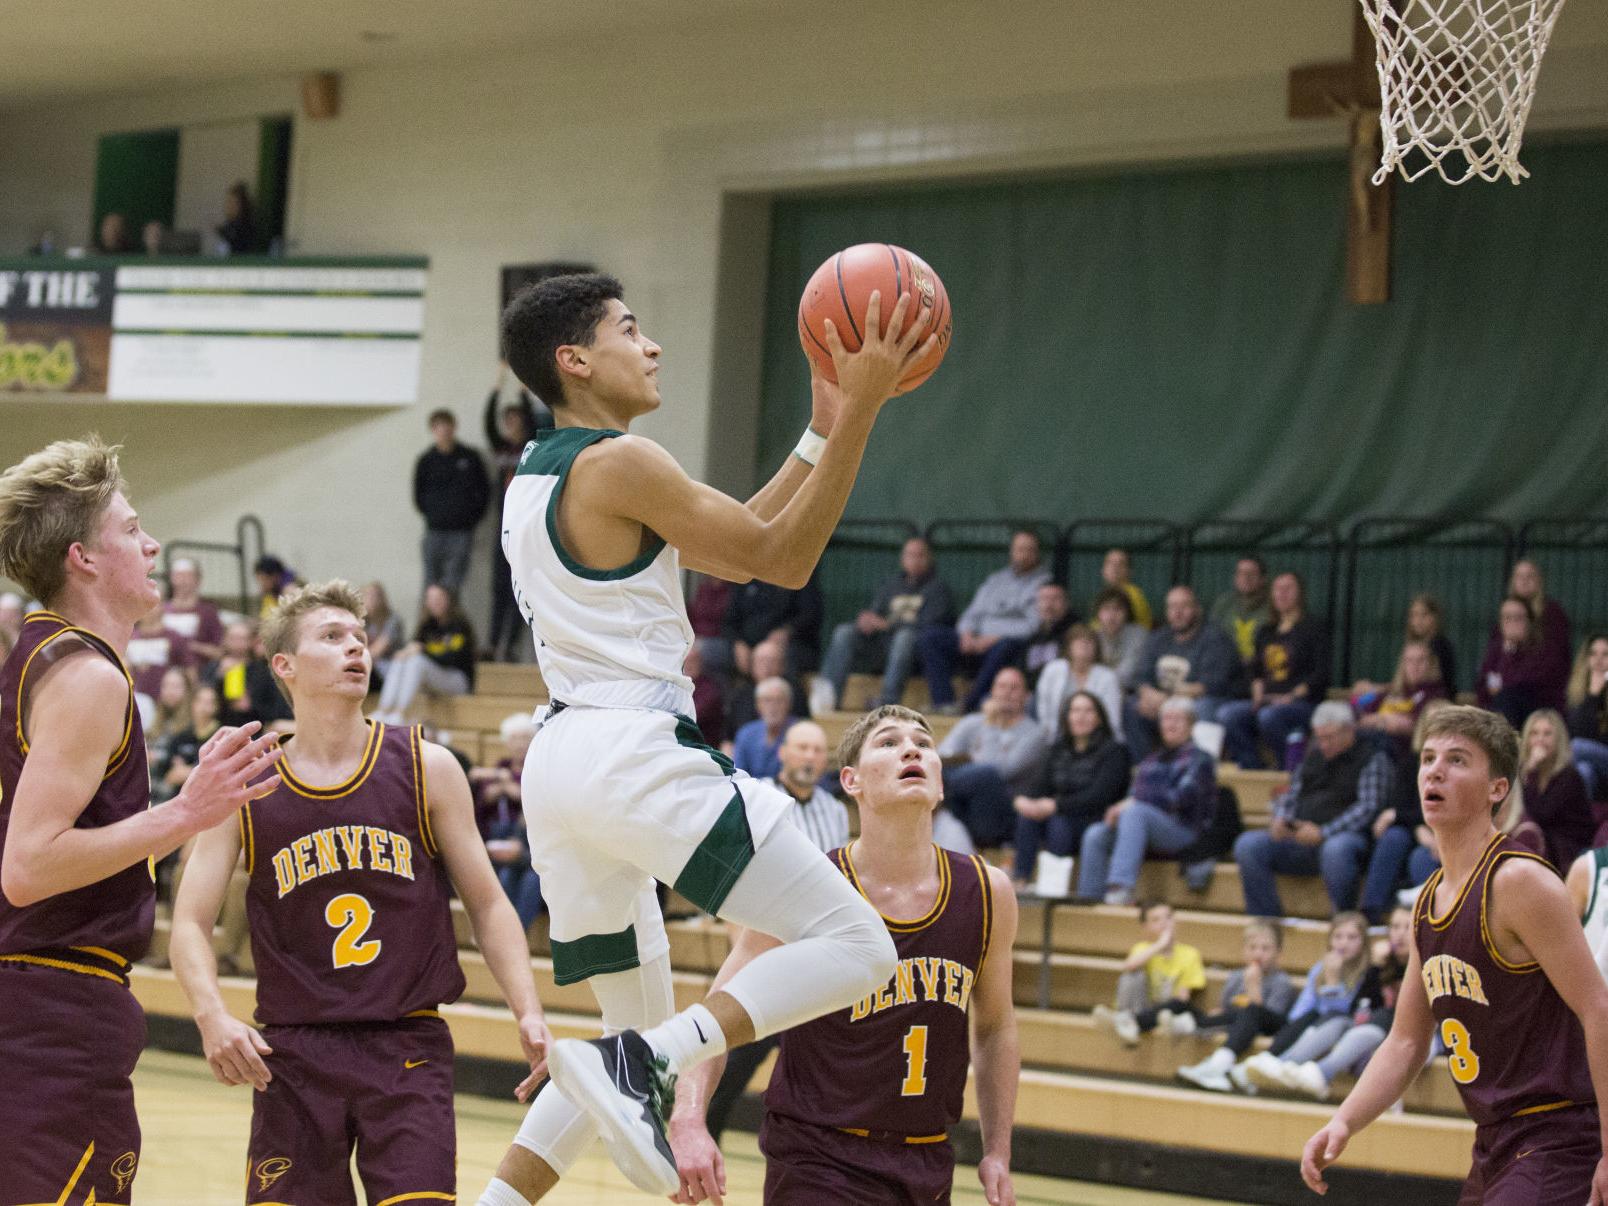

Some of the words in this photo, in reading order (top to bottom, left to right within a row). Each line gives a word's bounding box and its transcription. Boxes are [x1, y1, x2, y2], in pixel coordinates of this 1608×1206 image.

[22, 271, 99, 308] THE
[272, 825, 415, 899] DENVER
[325, 893, 381, 969] 2
[901, 1025, 928, 1096] 1
[1441, 1018, 1480, 1084] 3
